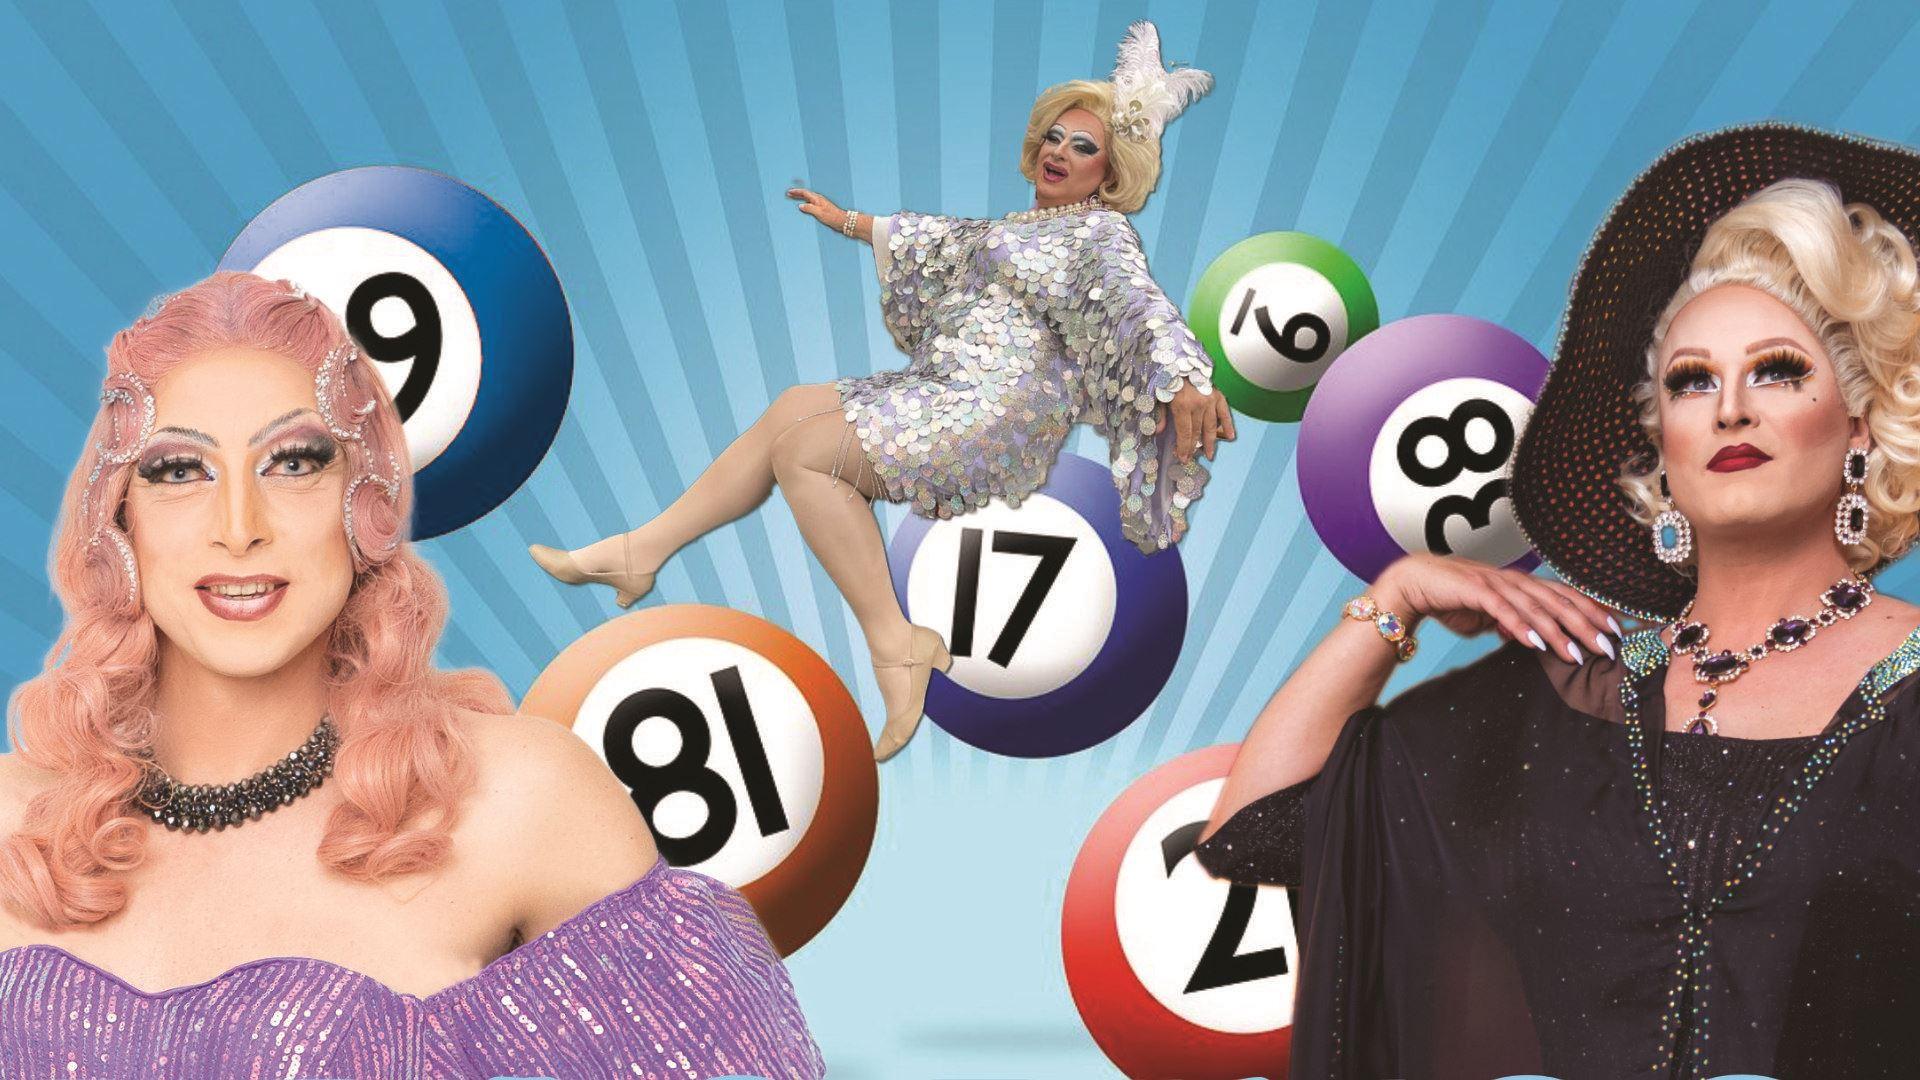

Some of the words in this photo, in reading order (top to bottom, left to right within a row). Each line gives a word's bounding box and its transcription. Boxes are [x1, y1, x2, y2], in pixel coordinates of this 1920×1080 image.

[346, 272, 442, 424] 9
[950, 528, 1078, 669] 17
[603, 665, 790, 868] 81
